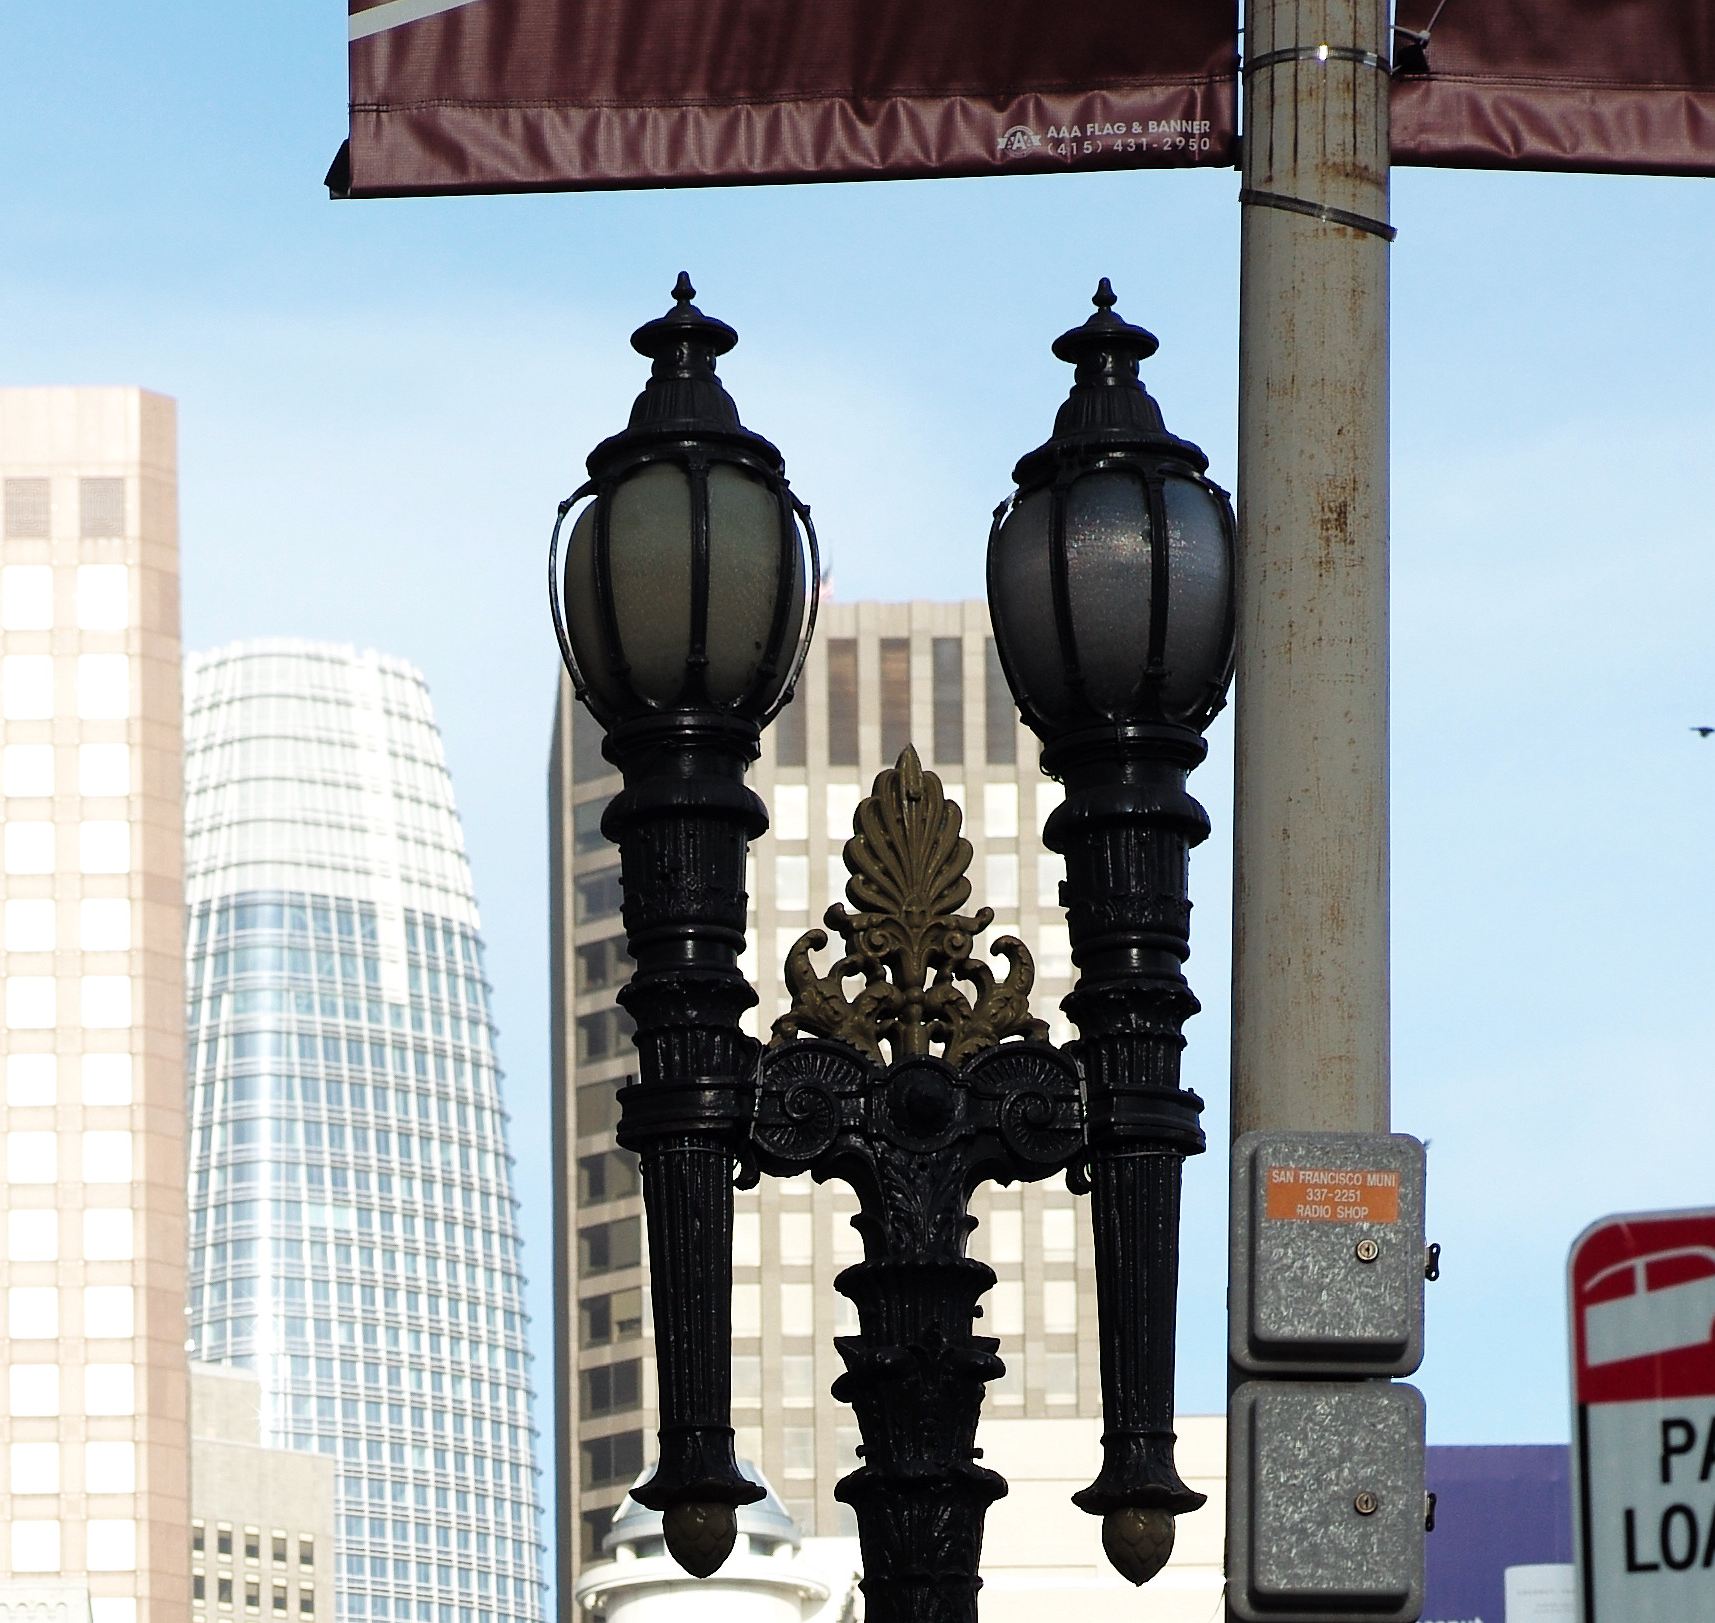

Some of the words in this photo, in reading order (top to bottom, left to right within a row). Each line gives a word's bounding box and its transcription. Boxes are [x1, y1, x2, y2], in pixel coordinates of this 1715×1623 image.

[1047, 125, 1082, 138] AAA
[1086, 122, 1127, 136] FLAG
[1131, 121, 1143, 133] &
[1148, 119, 1211, 134] BANNER
[1047, 139, 1103, 157] (415)
[1113, 136, 1211, 153] 431-2950
[1271, 1169, 1295, 1184] SAN
[1299, 1169, 1362, 1186] FRANCISCO
[1366, 1171, 1396, 1188] MUNI
[1305, 1187, 1362, 1204] 337-2251
[1296, 1203, 1331, 1219] RADIO
[1336, 1204, 1369, 1220] SHOP
[1625, 1502, 1715, 1575] LO
